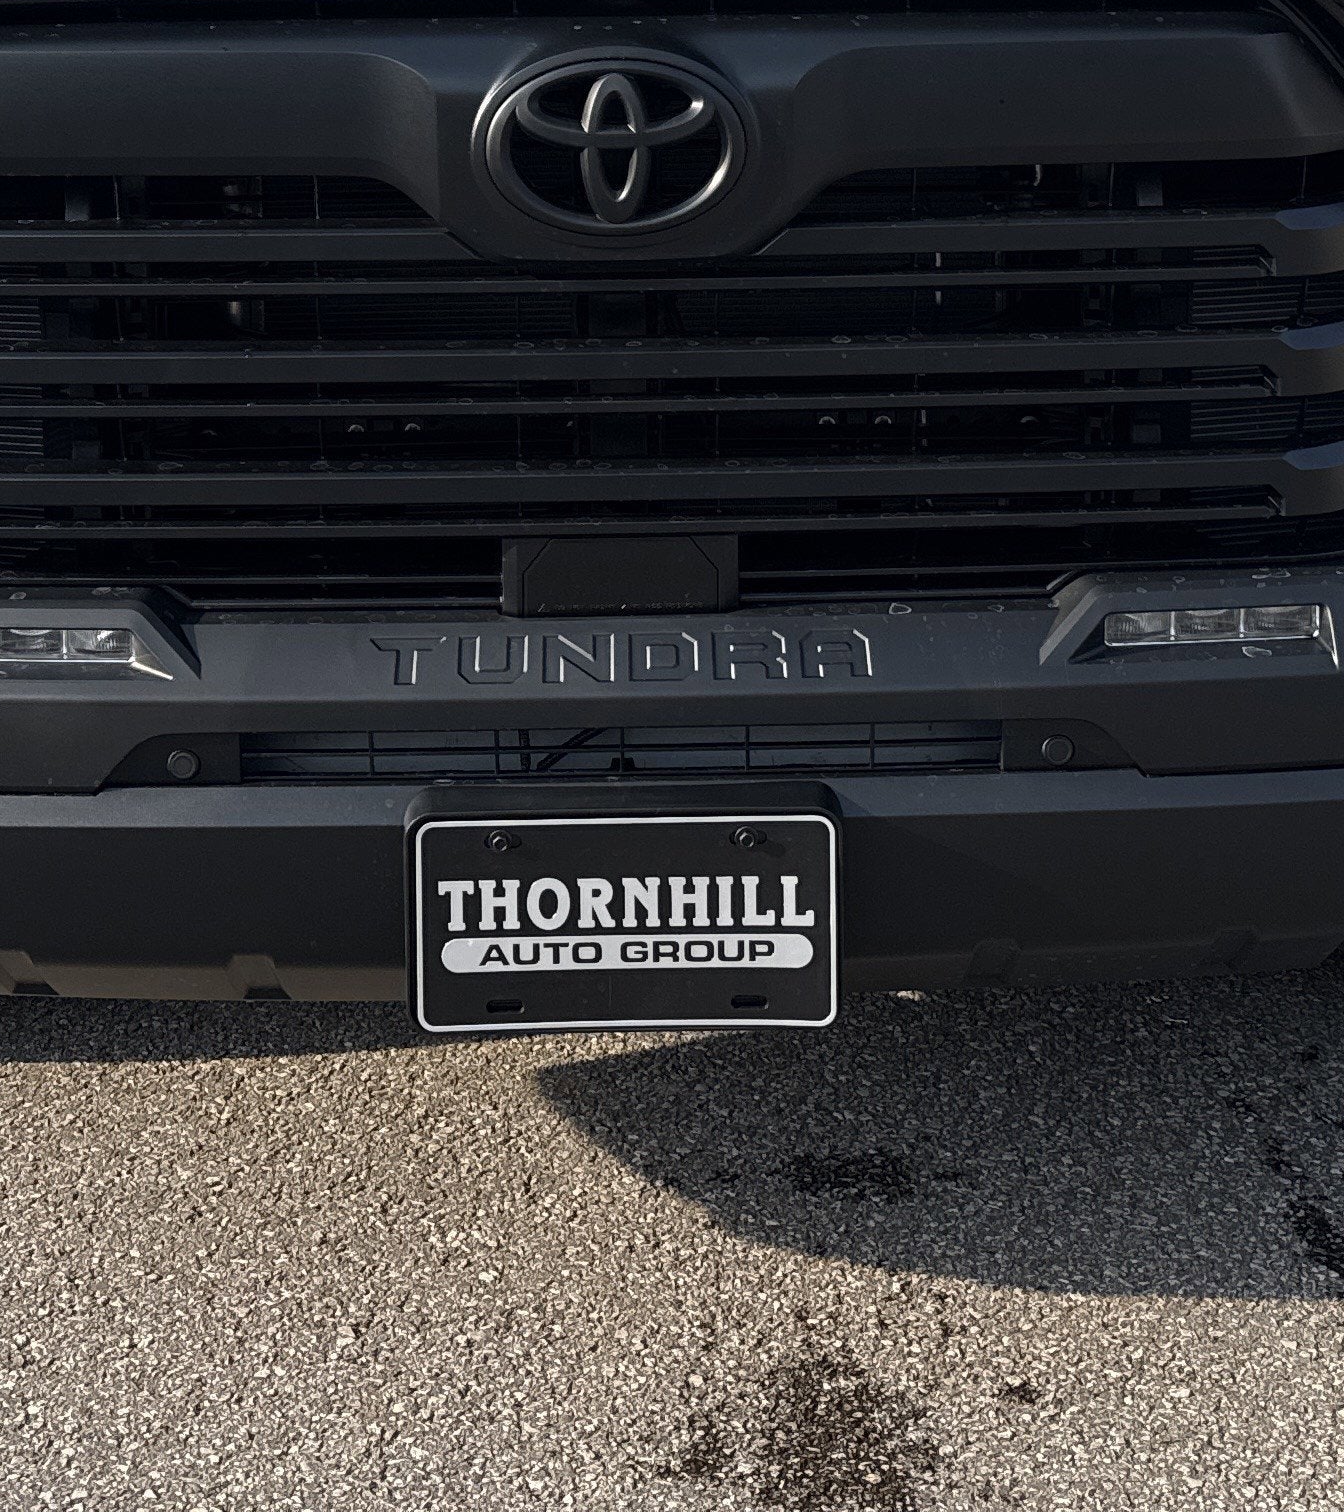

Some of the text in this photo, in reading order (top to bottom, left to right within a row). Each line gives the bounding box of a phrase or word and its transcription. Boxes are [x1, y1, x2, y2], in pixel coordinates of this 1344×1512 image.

[370, 629, 874, 685] TUNDRA
[438, 875, 815, 931] THORNHILL
[478, 939, 776, 967] AUTO GROUP
